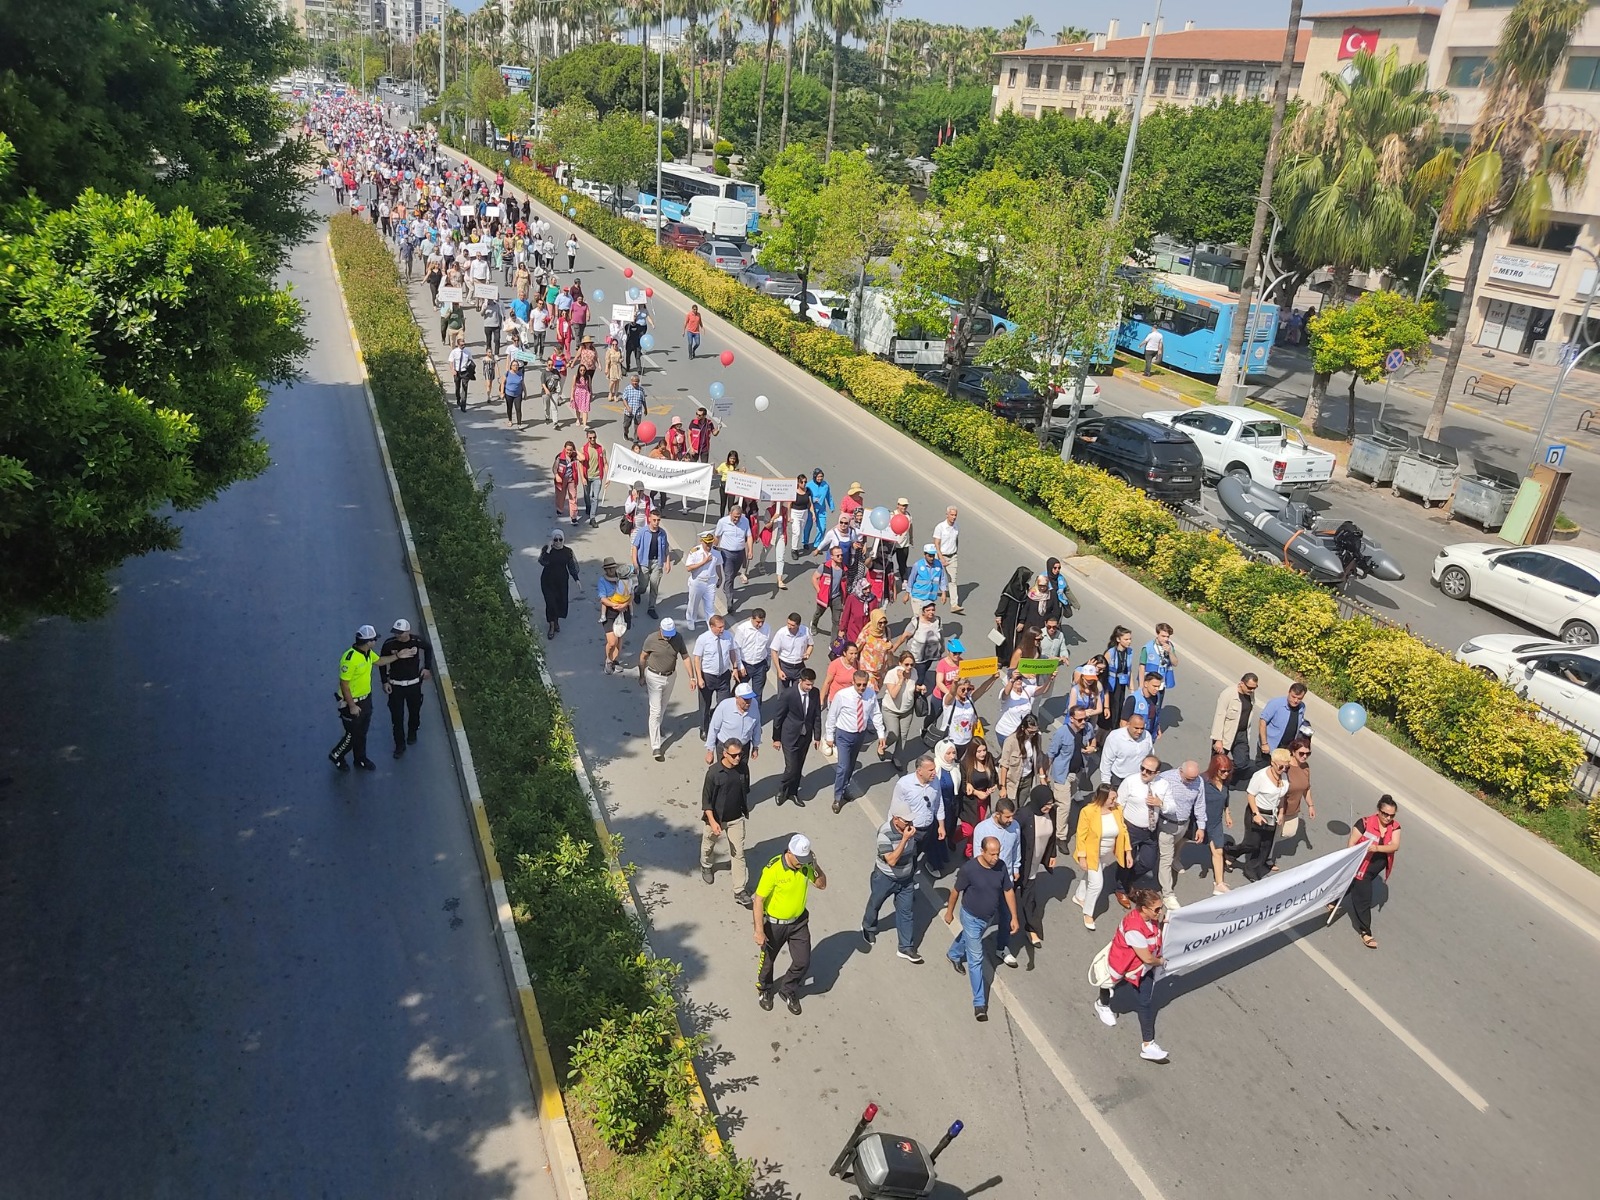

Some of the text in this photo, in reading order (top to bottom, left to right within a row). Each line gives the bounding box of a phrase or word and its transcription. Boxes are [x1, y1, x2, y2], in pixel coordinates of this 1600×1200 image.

[1498, 268, 1524, 278] METRO
[1550, 451, 1560, 464] D
[617, 463, 657, 478] KORUYUCU
[1183, 916, 1254, 954] KORUYUCU
[1255, 902, 1282, 923] AİLE
